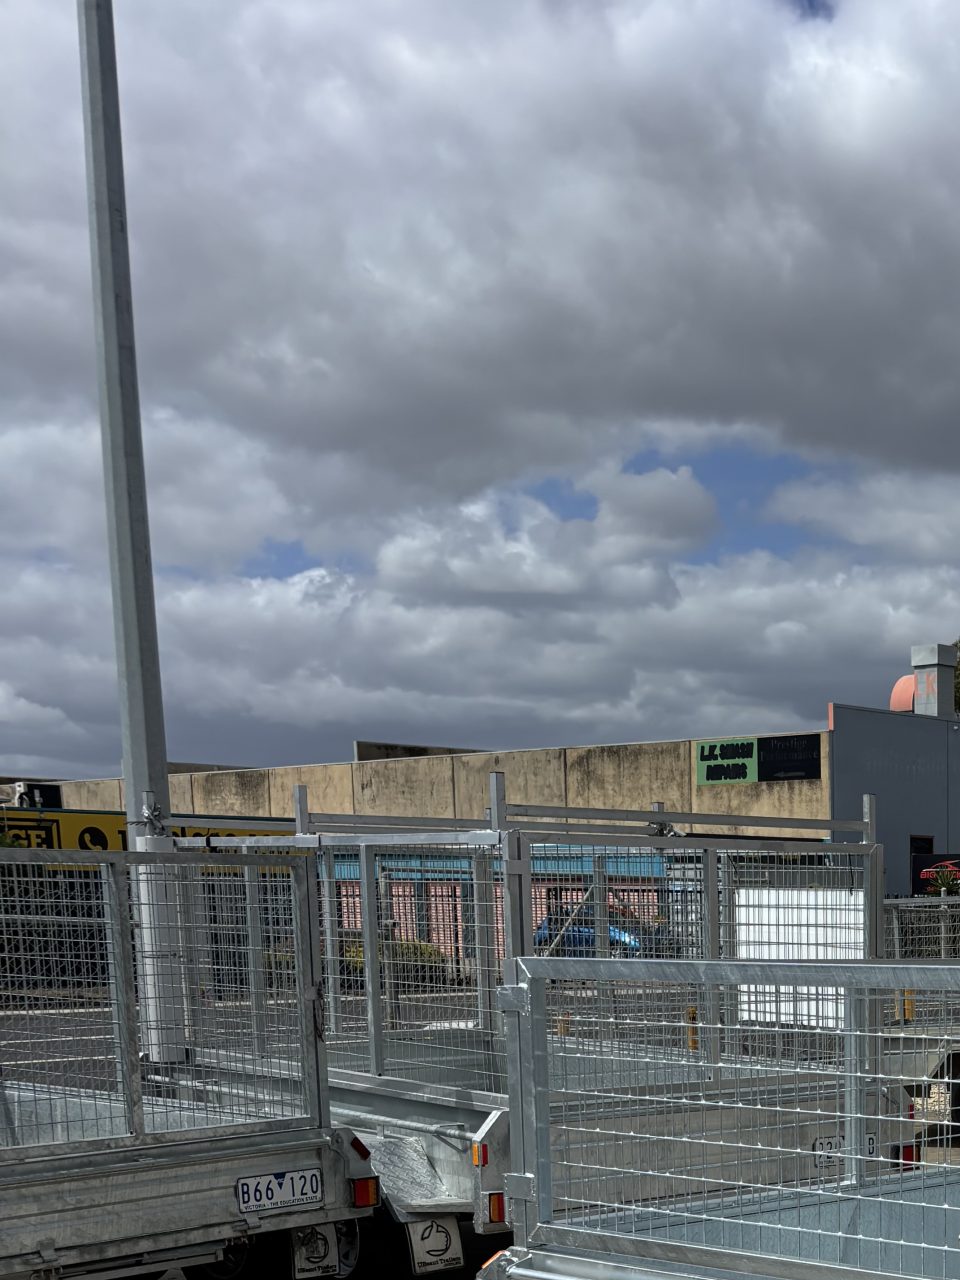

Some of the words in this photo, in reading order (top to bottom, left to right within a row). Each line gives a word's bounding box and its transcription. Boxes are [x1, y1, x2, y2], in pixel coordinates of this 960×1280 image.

[241, 1179, 274, 1204] B66
[290, 1173, 319, 1198] 120
[279, 1197, 305, 1206] EDUCATION
